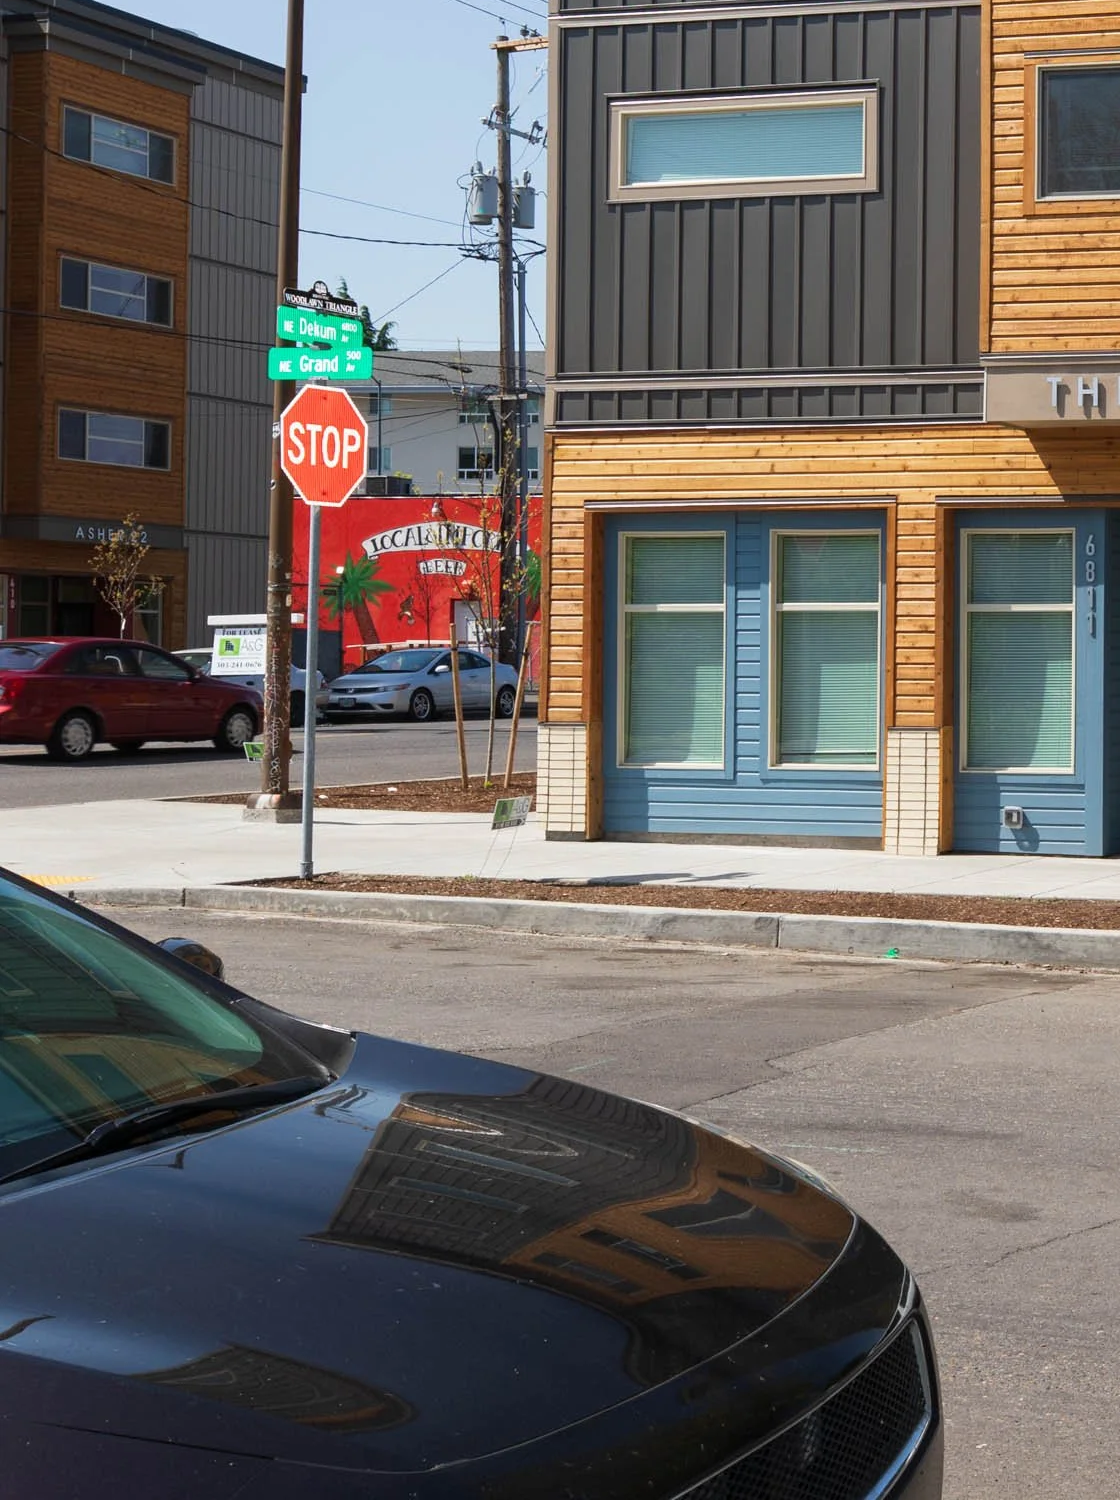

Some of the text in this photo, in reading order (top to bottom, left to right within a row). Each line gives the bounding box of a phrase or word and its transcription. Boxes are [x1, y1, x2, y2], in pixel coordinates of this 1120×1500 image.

[285, 293, 324, 309] WOODLAWN
[325, 300, 358, 316] TRIANGLE
[283, 320, 295, 333] NE
[299, 317, 337, 341] Dekum
[279, 360, 293, 373] NE
[299, 354, 339, 373] Grand
[346, 351, 362, 361] 500
[287, 421, 361, 470] STOP
[425, 559, 464, 575] BEER
[1085, 534, 1096, 635] 6811
[222, 627, 262, 637] FOR LEASE
